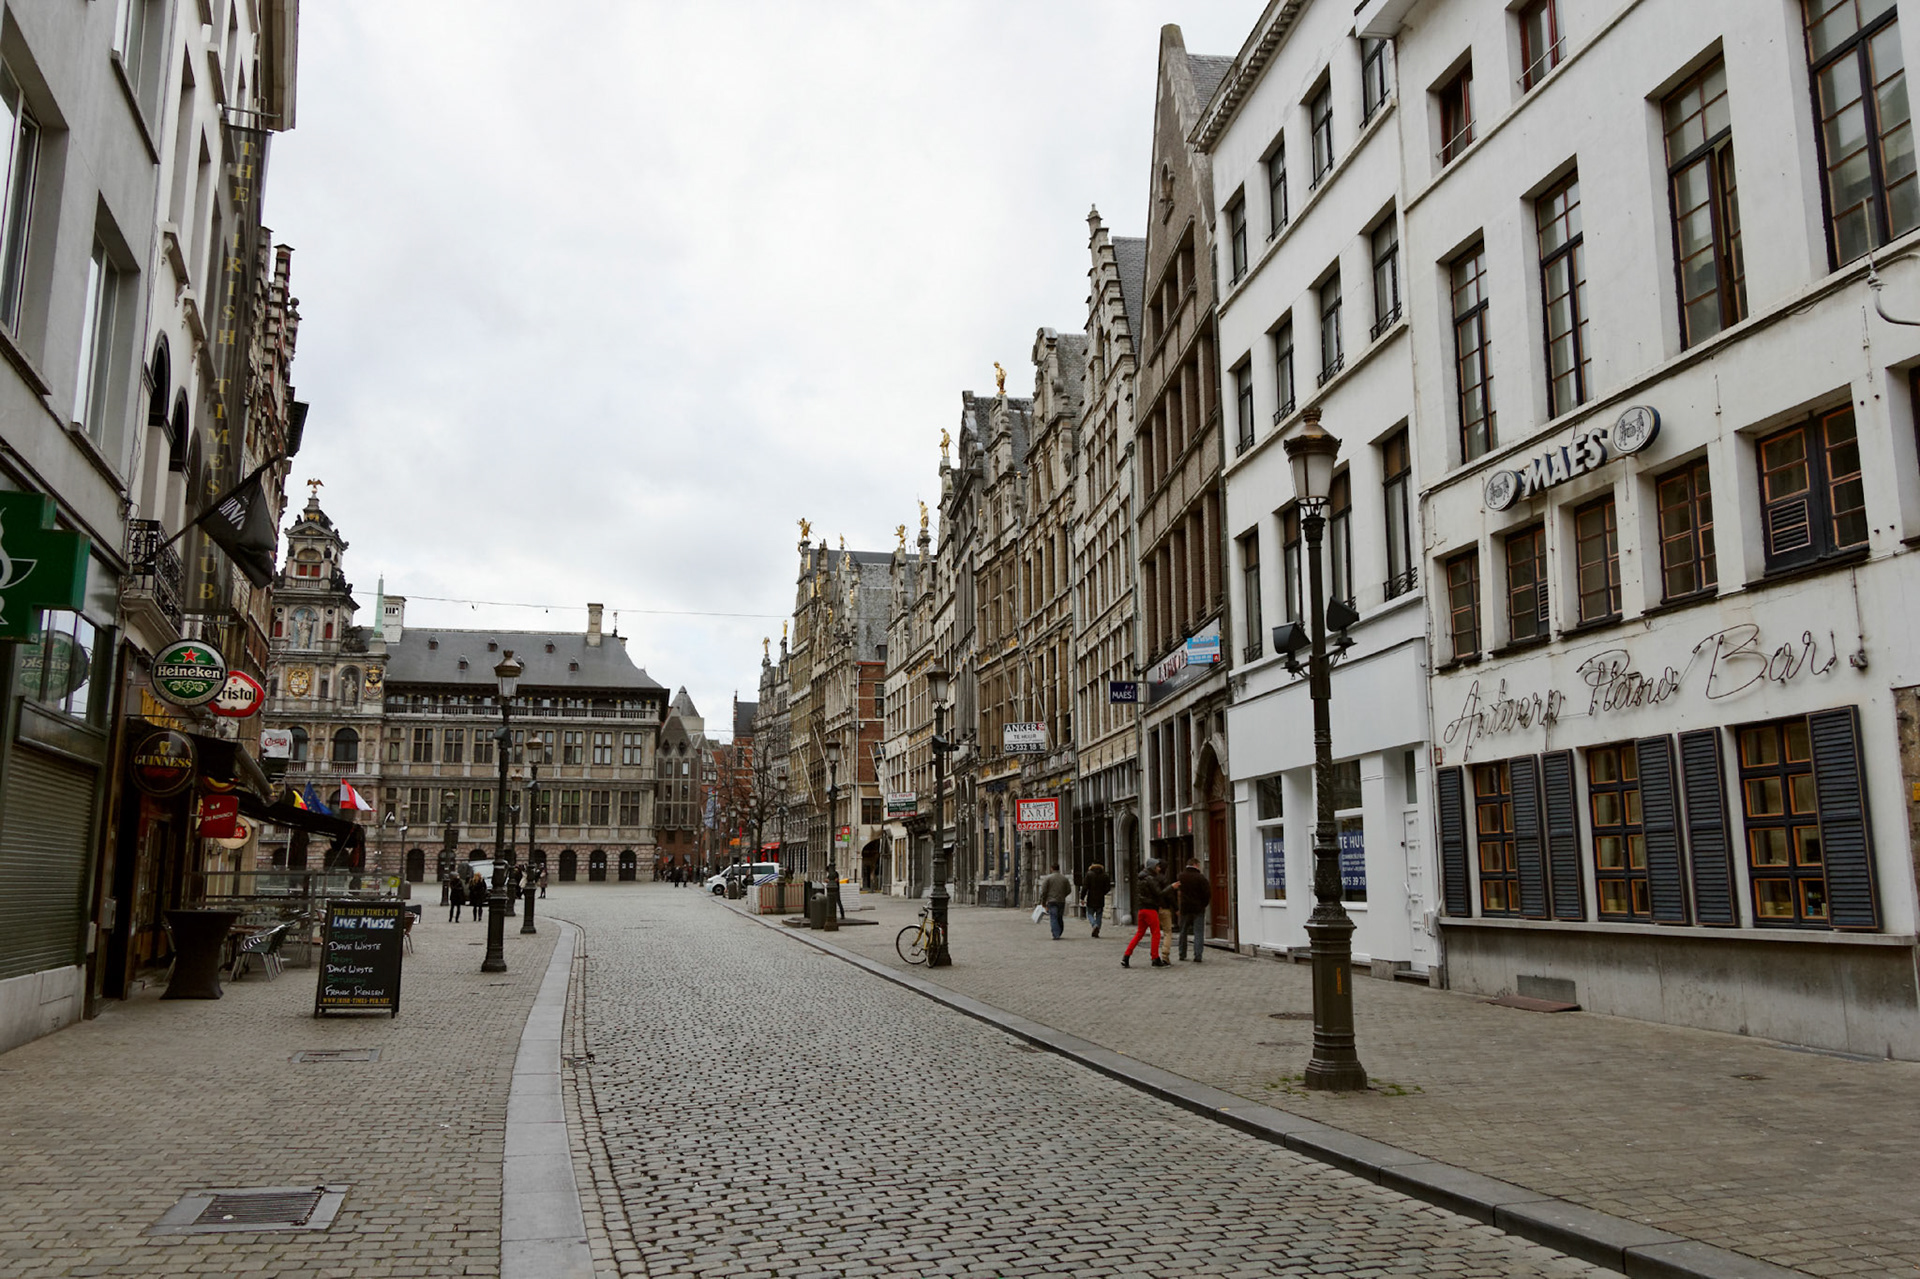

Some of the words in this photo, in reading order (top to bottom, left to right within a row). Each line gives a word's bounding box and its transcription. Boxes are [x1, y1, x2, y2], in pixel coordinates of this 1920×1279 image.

[234, 141, 255, 202] THE
[218, 234, 241, 345] IRISH
[206, 379, 231, 495] TIMES
[1524, 428, 1607, 497] MAES
[199, 533, 217, 599] UB
[157, 666, 220, 679] Heineken
[215, 686, 256, 703] ristal
[1112, 691, 1132, 699] MAES
[1444, 679, 1566, 762] Antwerp
[1577, 648, 1682, 716] Piano
[1693, 624, 1838, 699] Bar
[1005, 724, 1037, 733] ANKER
[135, 755, 193, 768] GUINNESS
[1021, 808, 1054, 818] PARIS
[1266, 842, 1272, 854] TE
[1338, 836, 1348, 849] TE
[1350, 835, 1365, 848] HUU
[347, 908, 365, 916] IRISH
[333, 917, 357, 929] LIVE
[359, 918, 396, 930] MUSIC
[328, 941, 352, 951] DAVE
[325, 963, 347, 973] DAVE
[325, 985, 350, 996] FRANK
